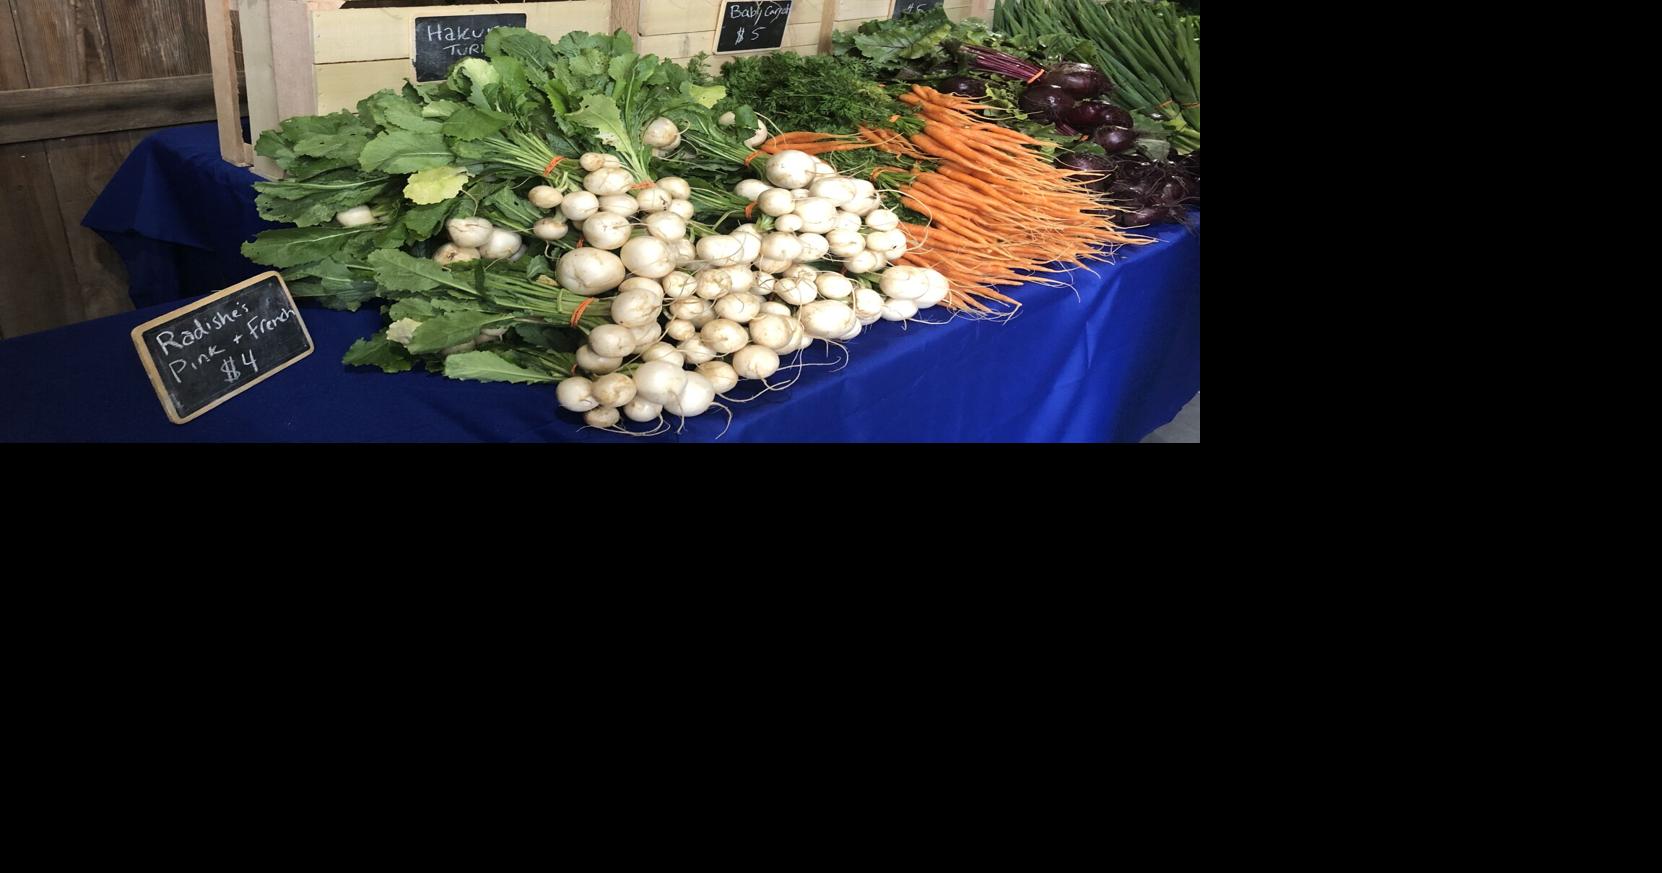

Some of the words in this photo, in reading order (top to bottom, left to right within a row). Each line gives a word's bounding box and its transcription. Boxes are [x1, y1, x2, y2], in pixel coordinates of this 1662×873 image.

[427, 23, 492, 42] Haku
[730, 5, 762, 26] Baby
[155, 301, 249, 356] Radishe's
[168, 344, 226, 384] Pink
[233, 334, 243, 344] +
[247, 308, 296, 340] French
[220, 349, 259, 383] $4
